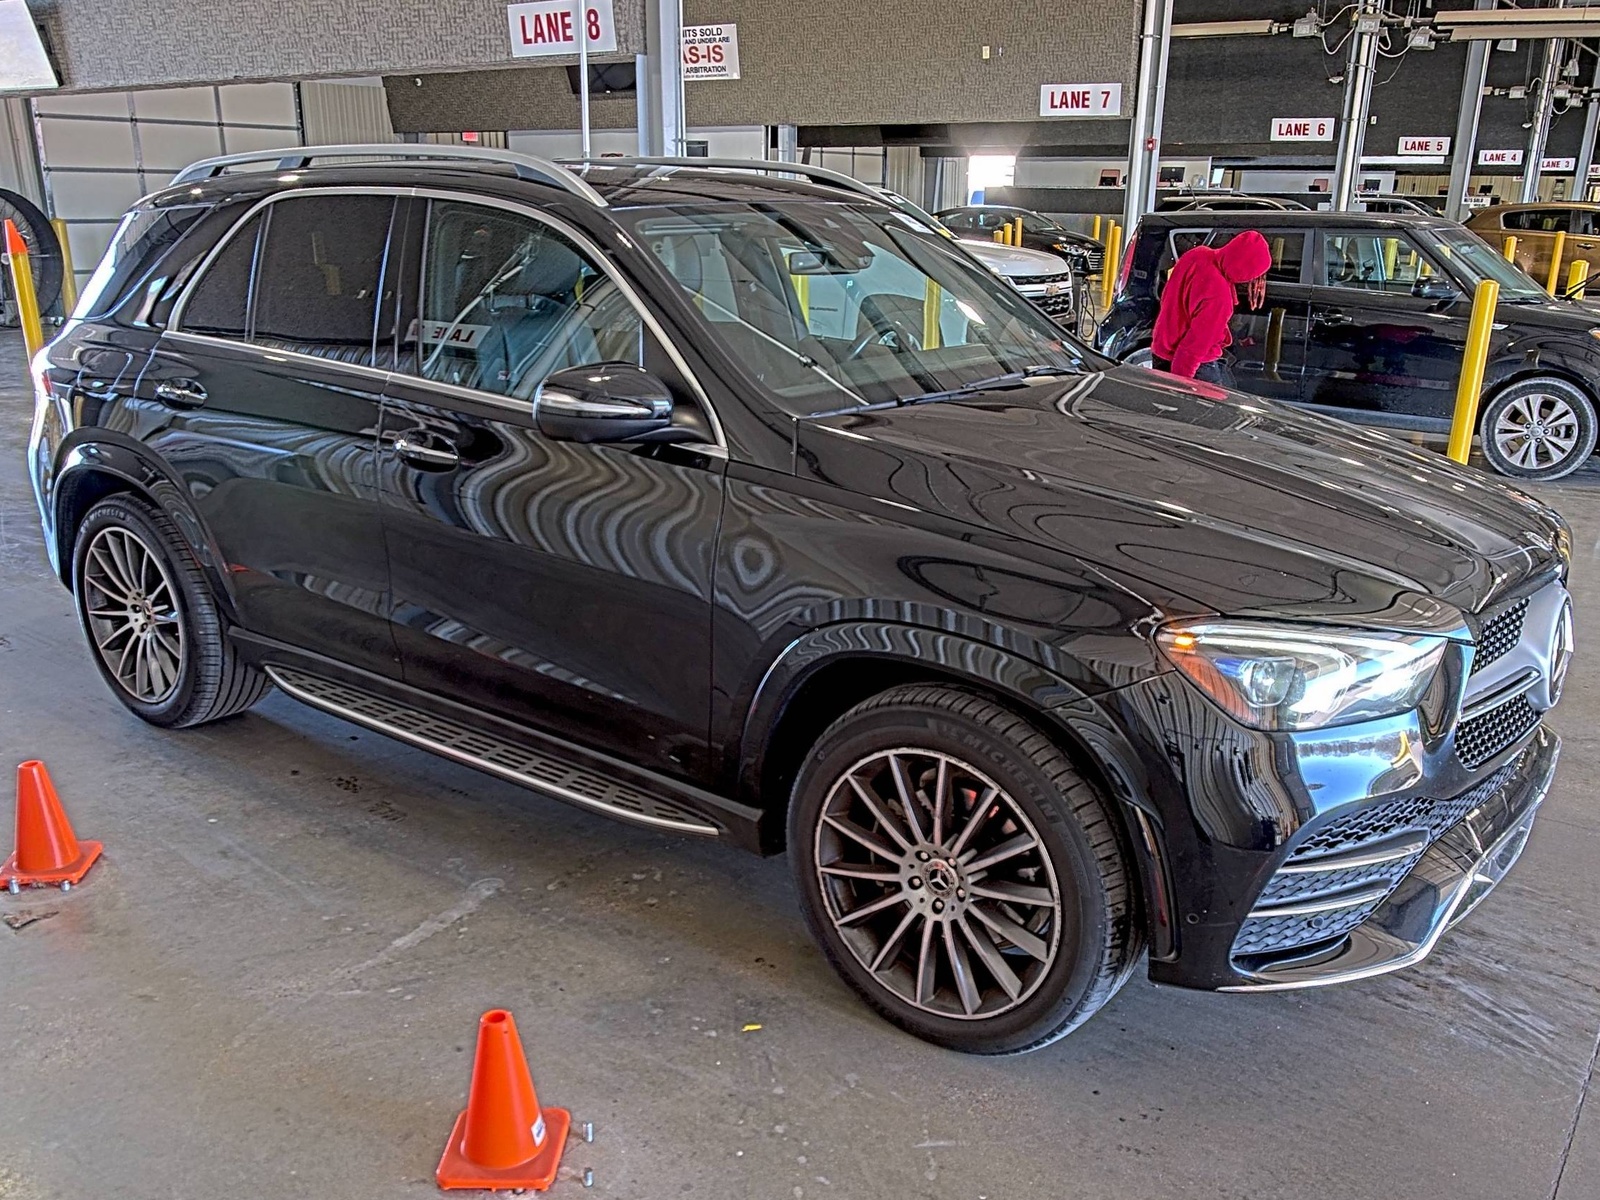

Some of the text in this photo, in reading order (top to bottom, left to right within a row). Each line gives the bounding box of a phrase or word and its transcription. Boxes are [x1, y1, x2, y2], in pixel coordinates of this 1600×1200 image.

[520, 8, 601, 45] LANE 8
[699, 27, 723, 37] SOLD
[685, 65, 727, 74] ARBITRATION
[1049, 90, 1111, 110] LANE 7
[1277, 122, 1326, 137] LANE 6
[1404, 141, 1443, 151] LANE 5
[1484, 153, 1517, 162] LANE 4
[963, 734, 1061, 824] MICHELIN
